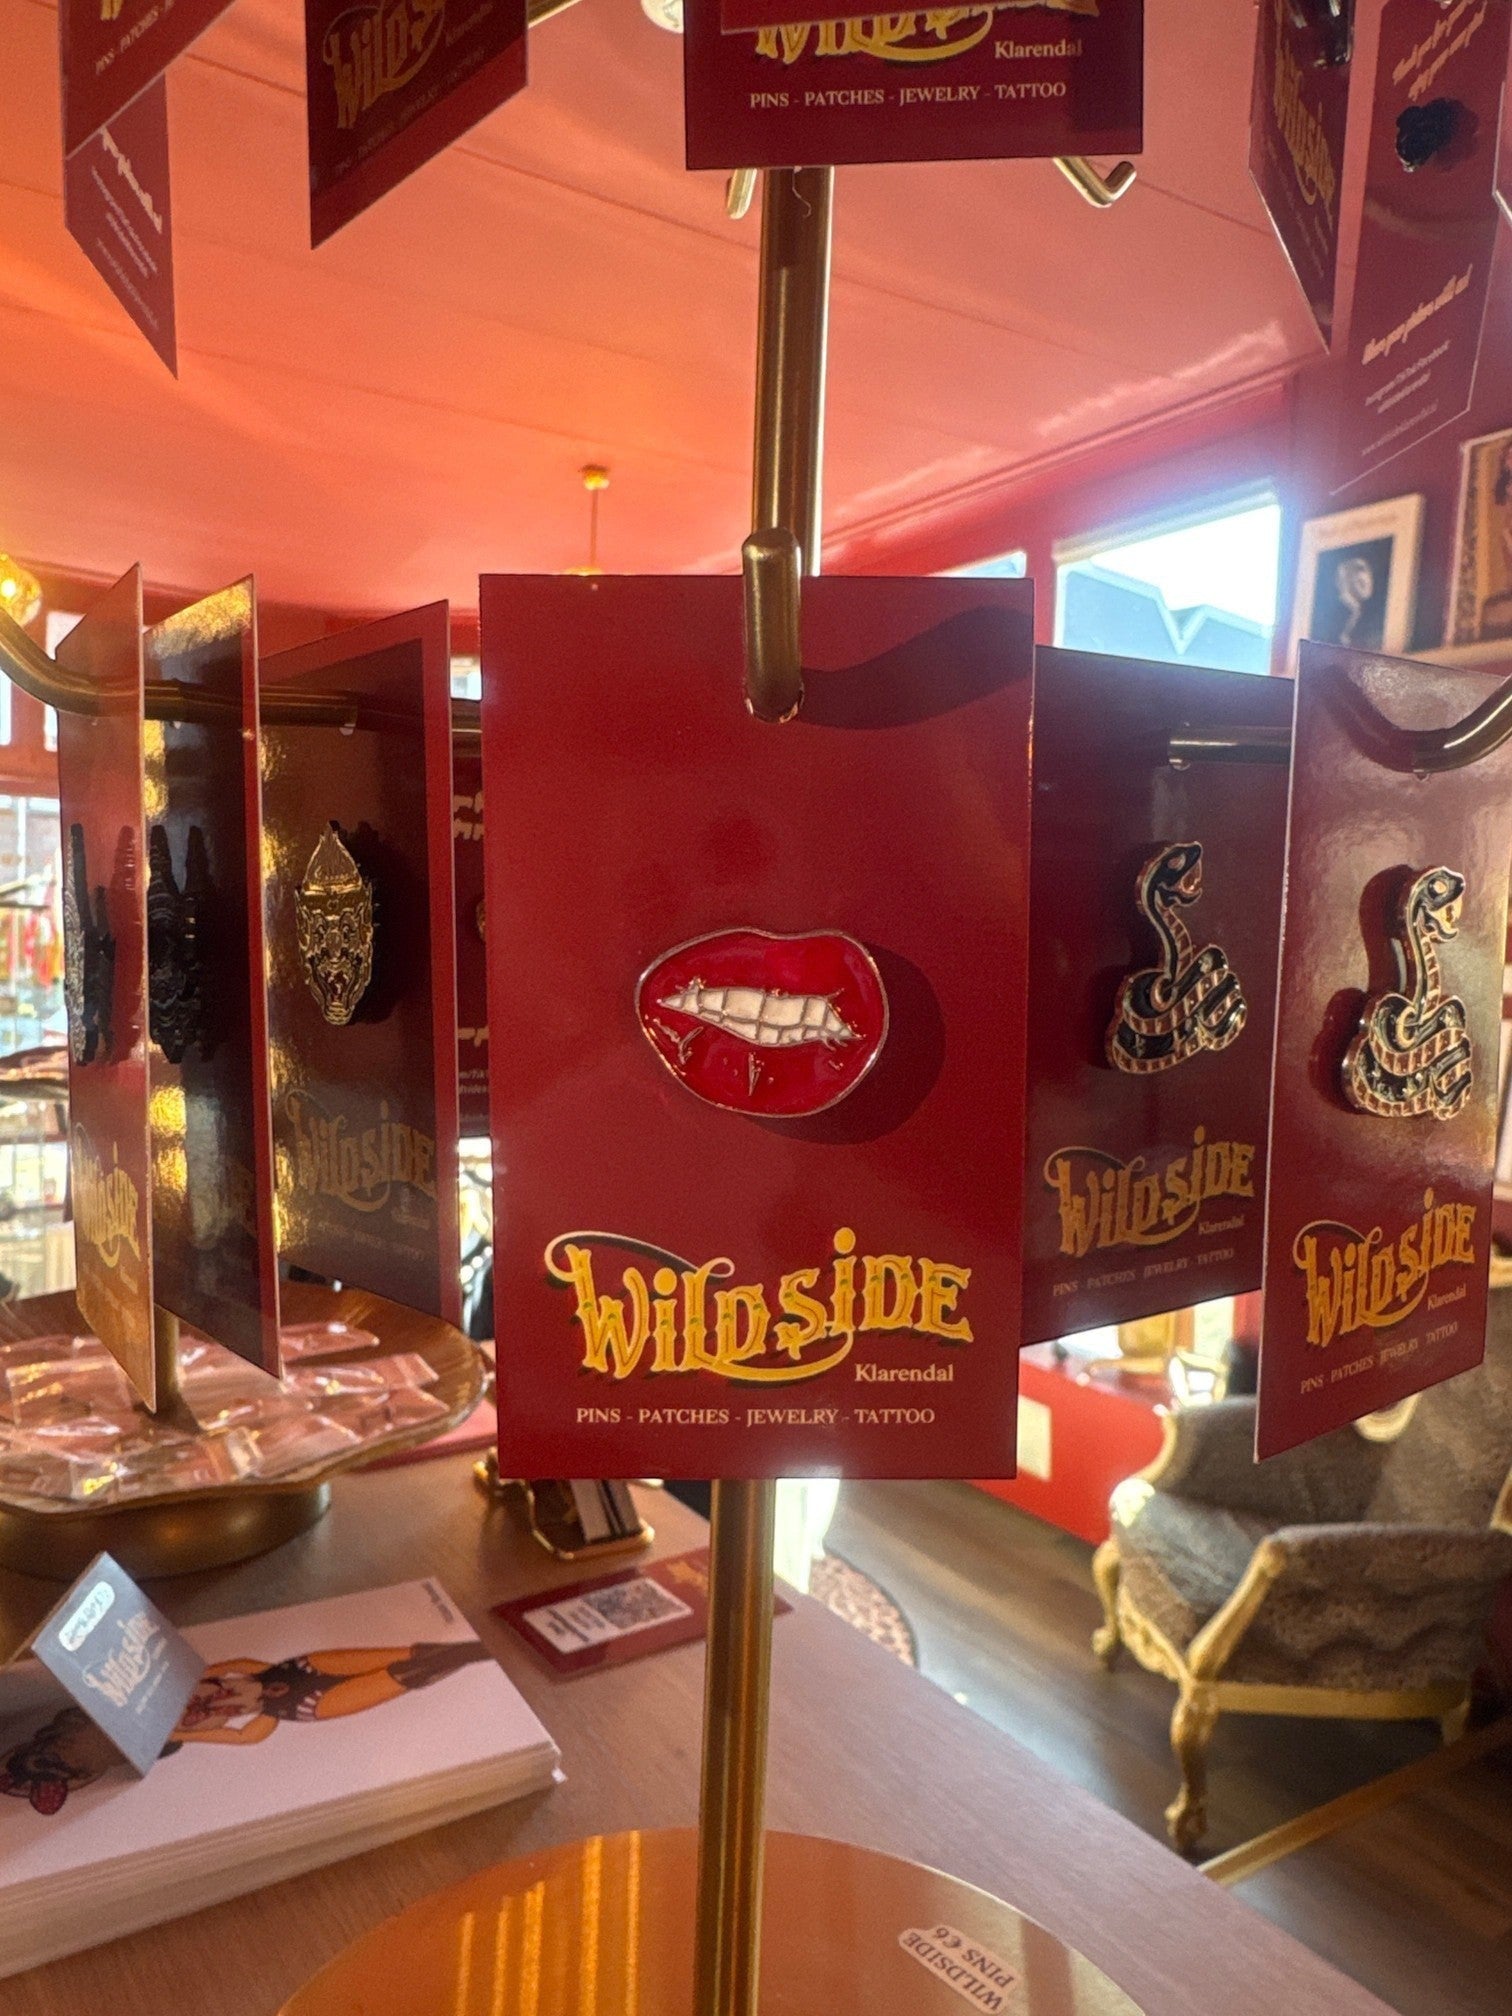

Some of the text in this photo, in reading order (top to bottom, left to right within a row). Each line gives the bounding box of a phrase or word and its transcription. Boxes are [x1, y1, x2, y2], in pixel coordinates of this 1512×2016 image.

[994, 39, 1083, 59] Klarendal
[749, 92, 790, 109] PINS
[804, 88, 885, 107] PATCHES
[899, 86, 981, 106] JEWELRY
[994, 82, 1067, 100] TATTOO
[854, 1363, 954, 1383] Klarendal
[576, 1407, 621, 1424] PINS
[638, 1407, 730, 1424] PATCHES
[746, 1408, 839, 1427] JEWELRY
[853, 1407, 936, 1424] TATTOO
[902, 1931, 1003, 2011] WILDSIDE
[961, 1948, 1015, 1989] PINS
